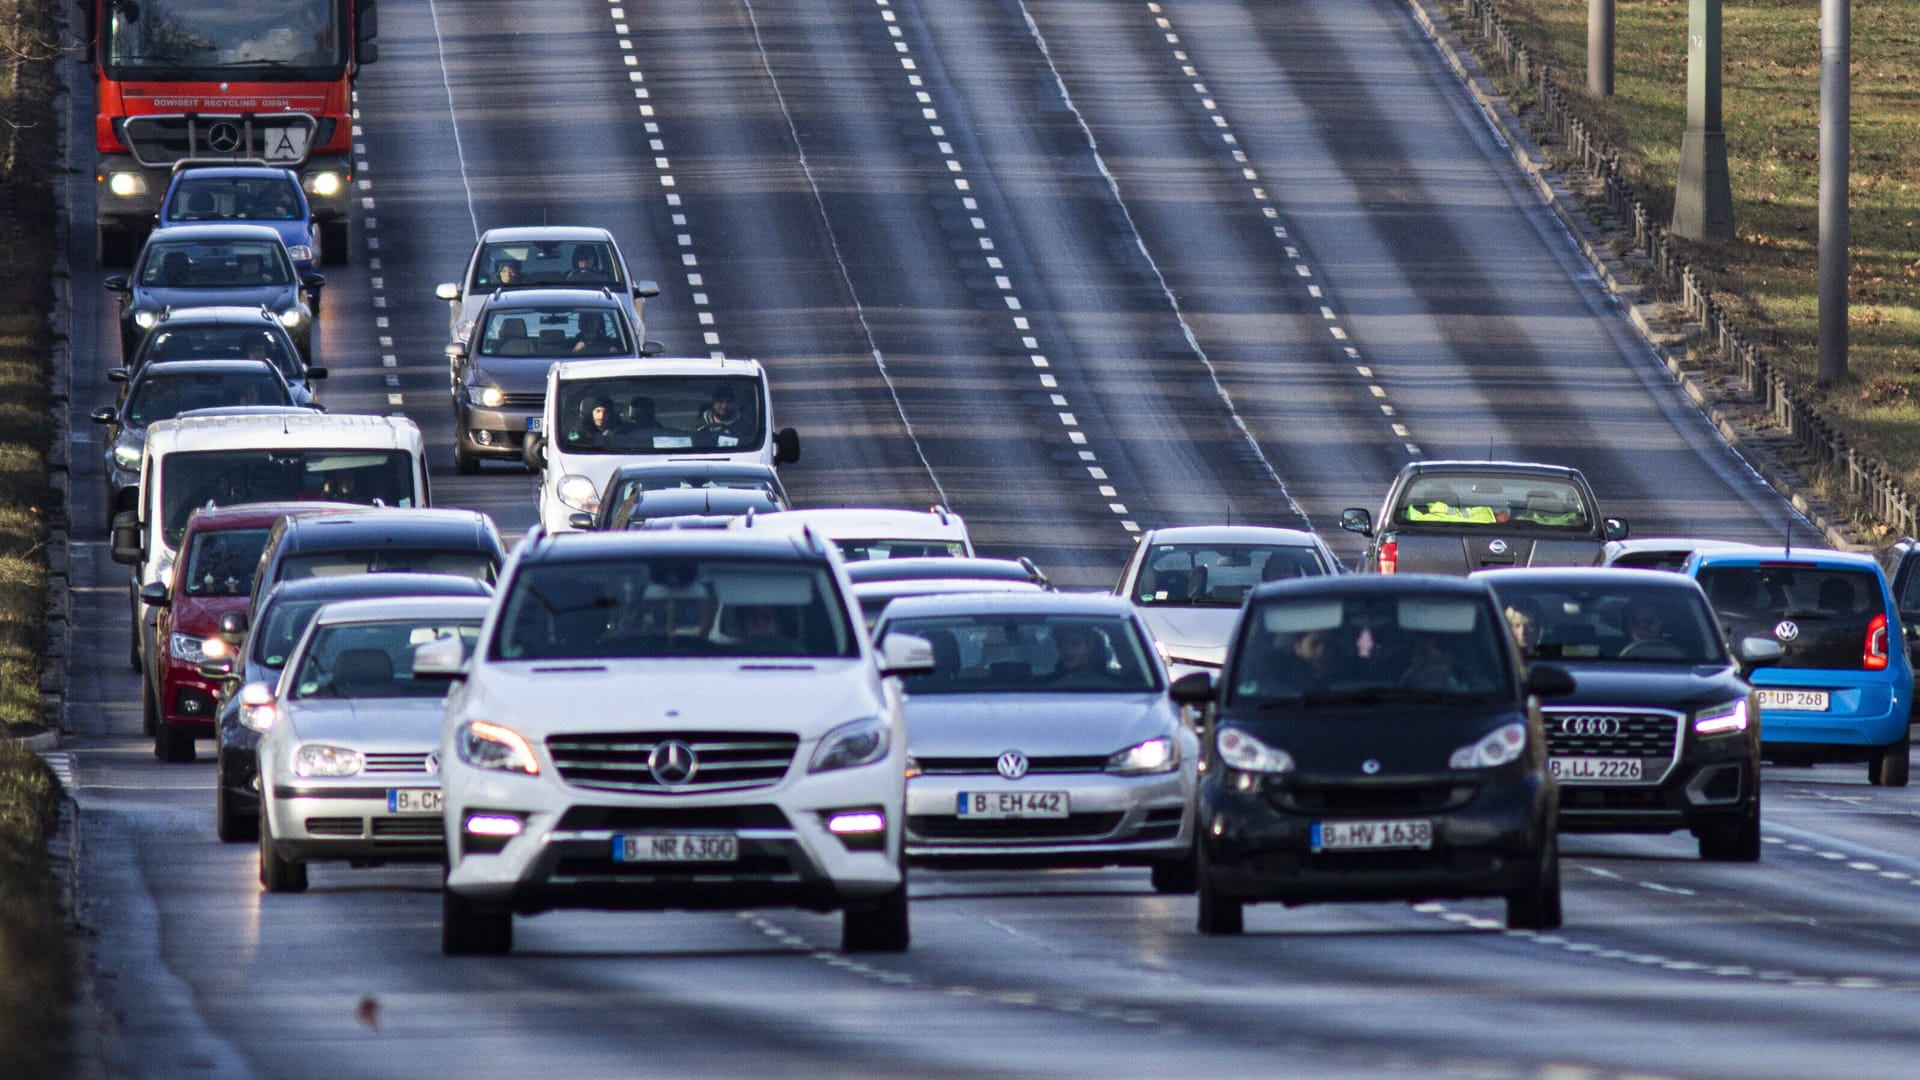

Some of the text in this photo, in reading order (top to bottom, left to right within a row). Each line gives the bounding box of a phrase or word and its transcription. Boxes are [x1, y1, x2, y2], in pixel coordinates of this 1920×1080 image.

[204, 99, 257, 107] RECYCLING
[262, 99, 289, 107] GMBH
[274, 133, 296, 154] A
[1758, 691, 1823, 706] B UP 268
[1551, 761, 1640, 777] B LL 2226
[399, 792, 409, 808] B
[975, 794, 1060, 812] B EH 442
[1324, 823, 1430, 844] B HV 1638
[625, 837, 734, 857] B NR 6300
